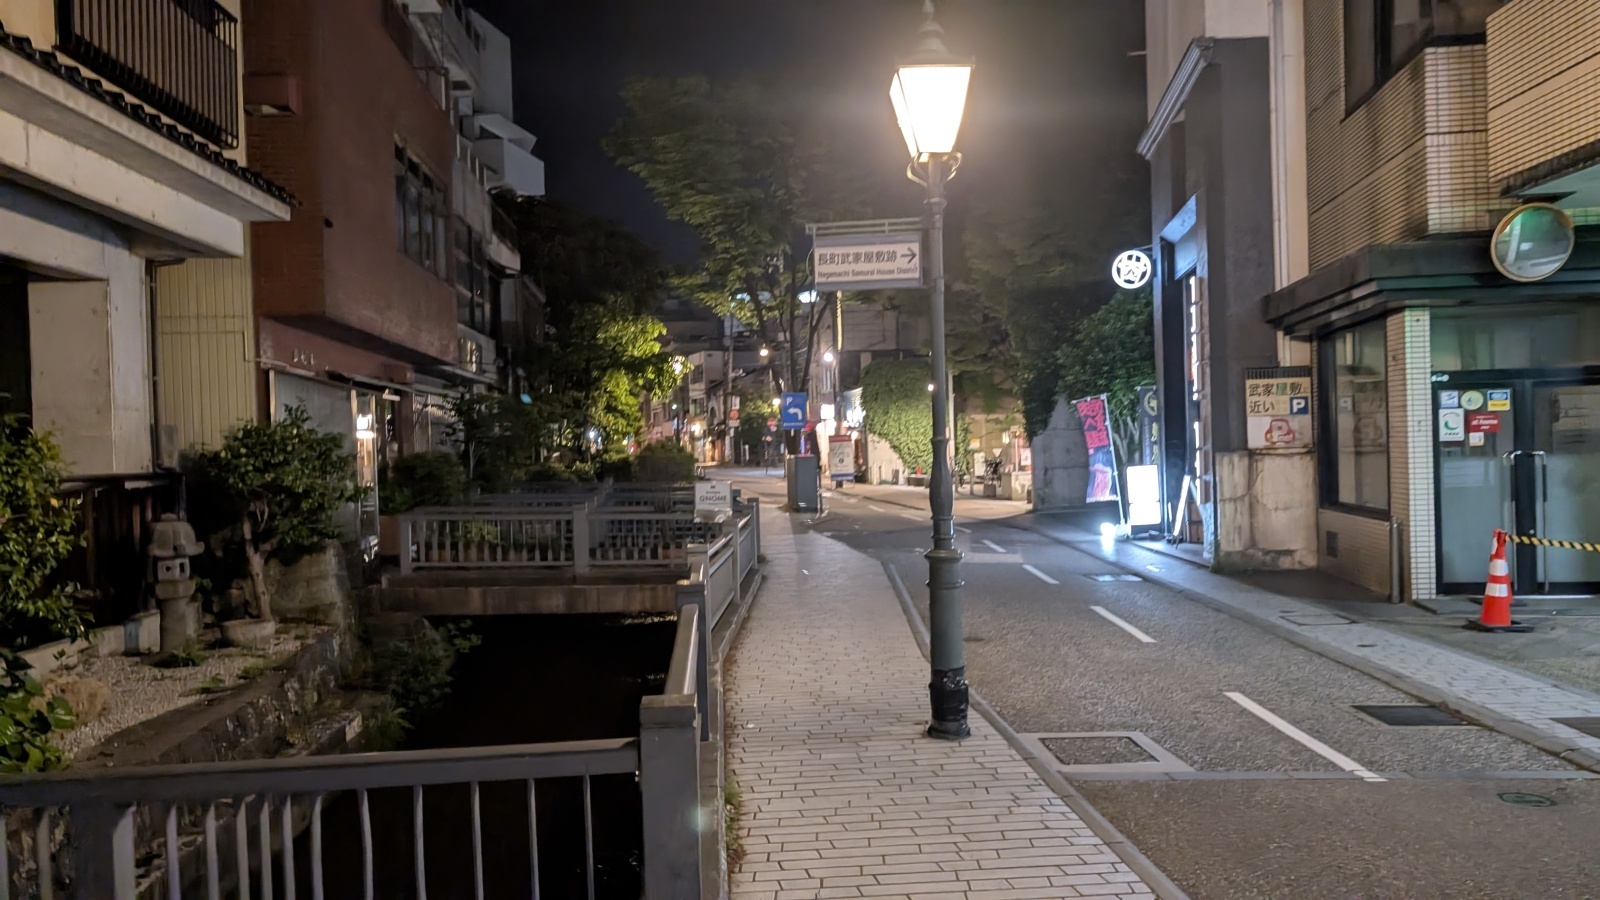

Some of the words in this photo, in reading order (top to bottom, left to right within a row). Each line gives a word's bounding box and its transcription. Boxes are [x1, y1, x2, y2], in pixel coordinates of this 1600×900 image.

[818, 250, 897, 265] 長町武家屋敷跡
[818, 270, 851, 280] Nagamachi
[851, 268, 875, 277] Samurai
[876, 266, 896, 275] House
[897, 264, 918, 274] District
[1249, 401, 1275, 413] 近い
[1292, 398, 1306, 413] P
